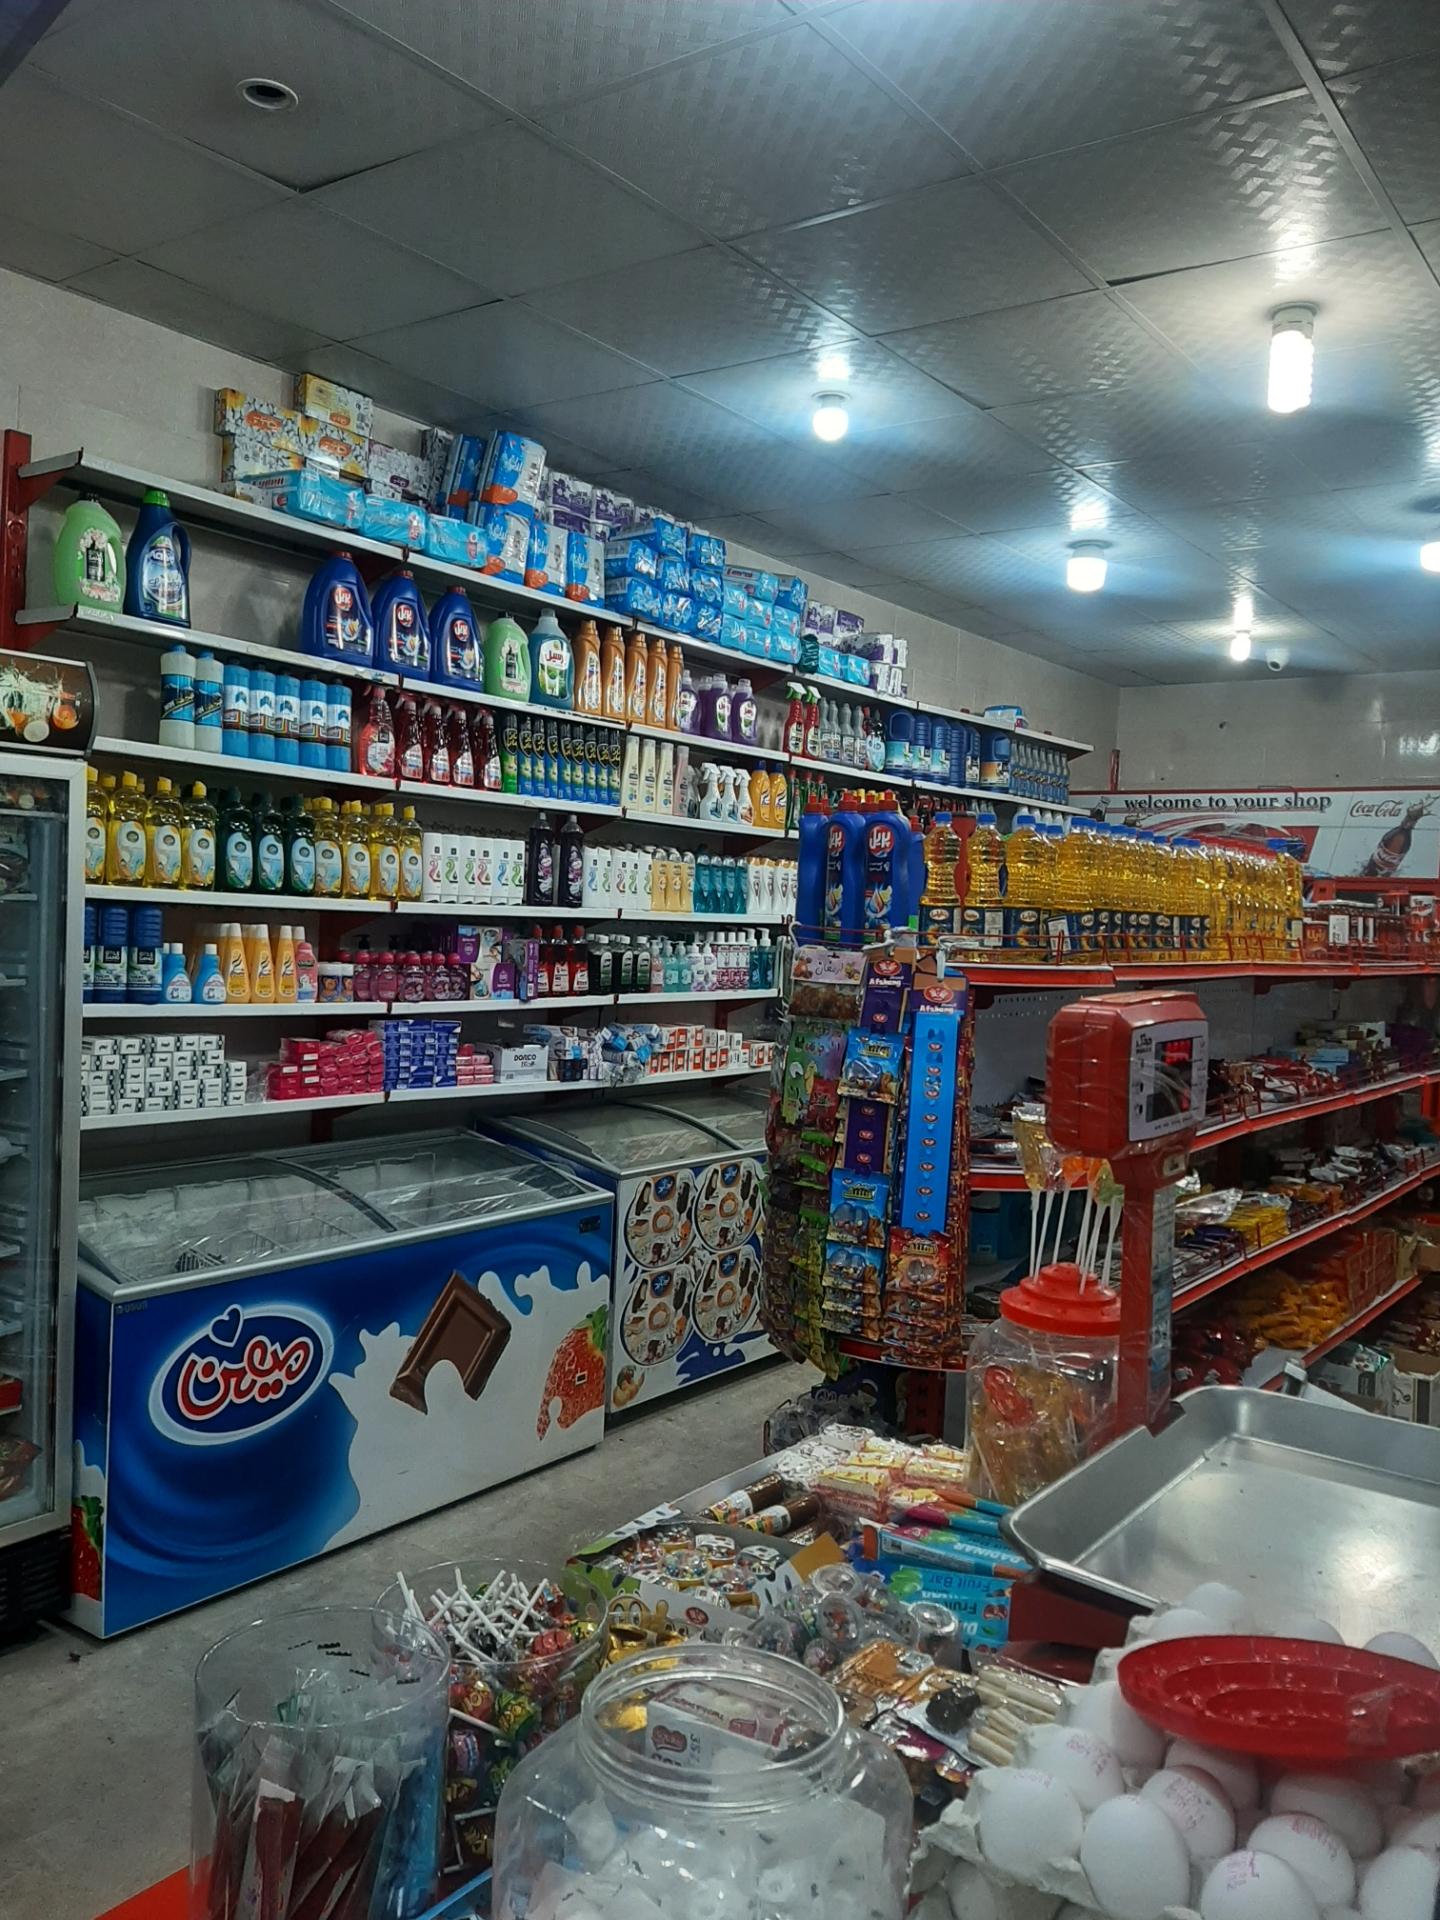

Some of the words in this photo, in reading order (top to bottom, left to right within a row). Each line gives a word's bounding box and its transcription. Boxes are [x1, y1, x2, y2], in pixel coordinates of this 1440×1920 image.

[1124, 794, 1203, 809] welcome
[1209, 795, 1226, 809] to
[1233, 796, 1280, 813] your
[1285, 792, 1331, 813] shop
[178, 1336, 313, 1420] میهن
[928, 1575, 952, 1588] Bar
[958, 1579, 992, 1593] Fruit
